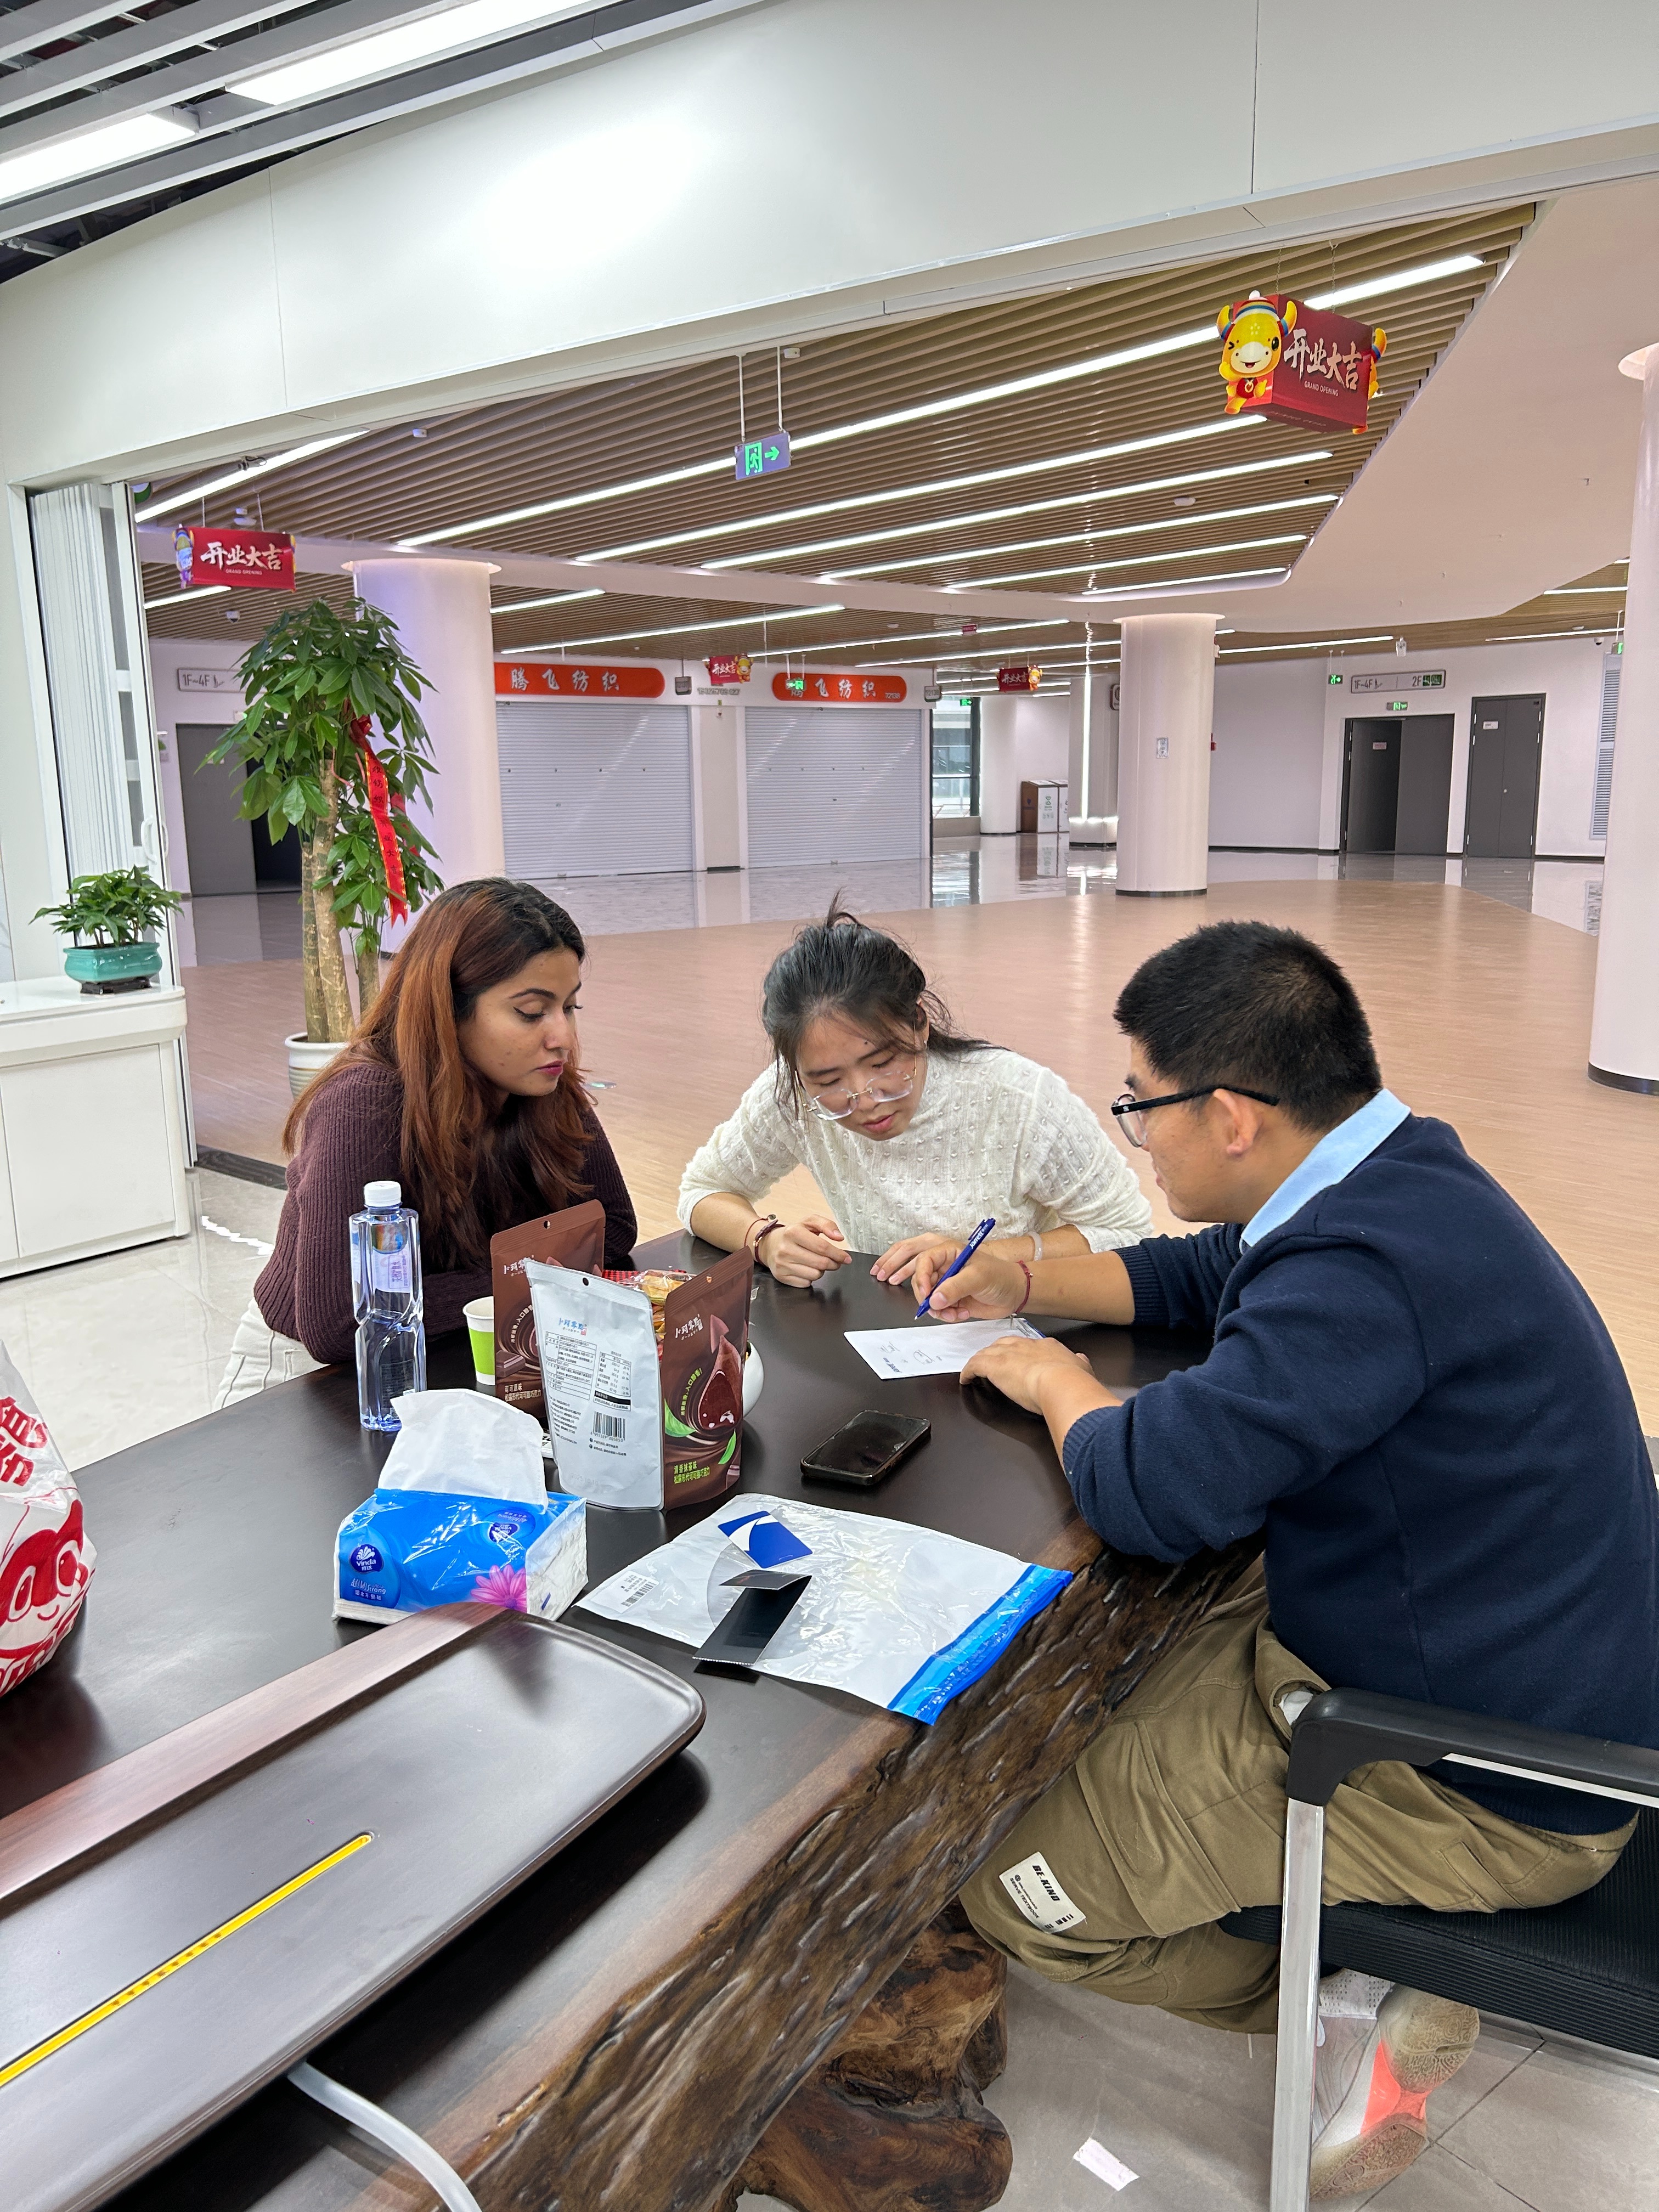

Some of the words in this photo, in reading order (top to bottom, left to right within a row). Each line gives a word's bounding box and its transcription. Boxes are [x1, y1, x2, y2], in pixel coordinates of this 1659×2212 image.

[1284, 329, 1362, 390] 开业大吉
[1304, 380, 1319, 391] GRAND
[1320, 385, 1339, 396] OPENING
[200, 541, 283, 571] 开业大吉
[712, 661, 736, 675] 开业大吉
[511, 667, 620, 692] 腾飞纺织
[1412, 675, 1422, 687] 2F
[366, 1583, 386, 1595] Strong
[1010, 1877, 1021, 1894] SERVE
